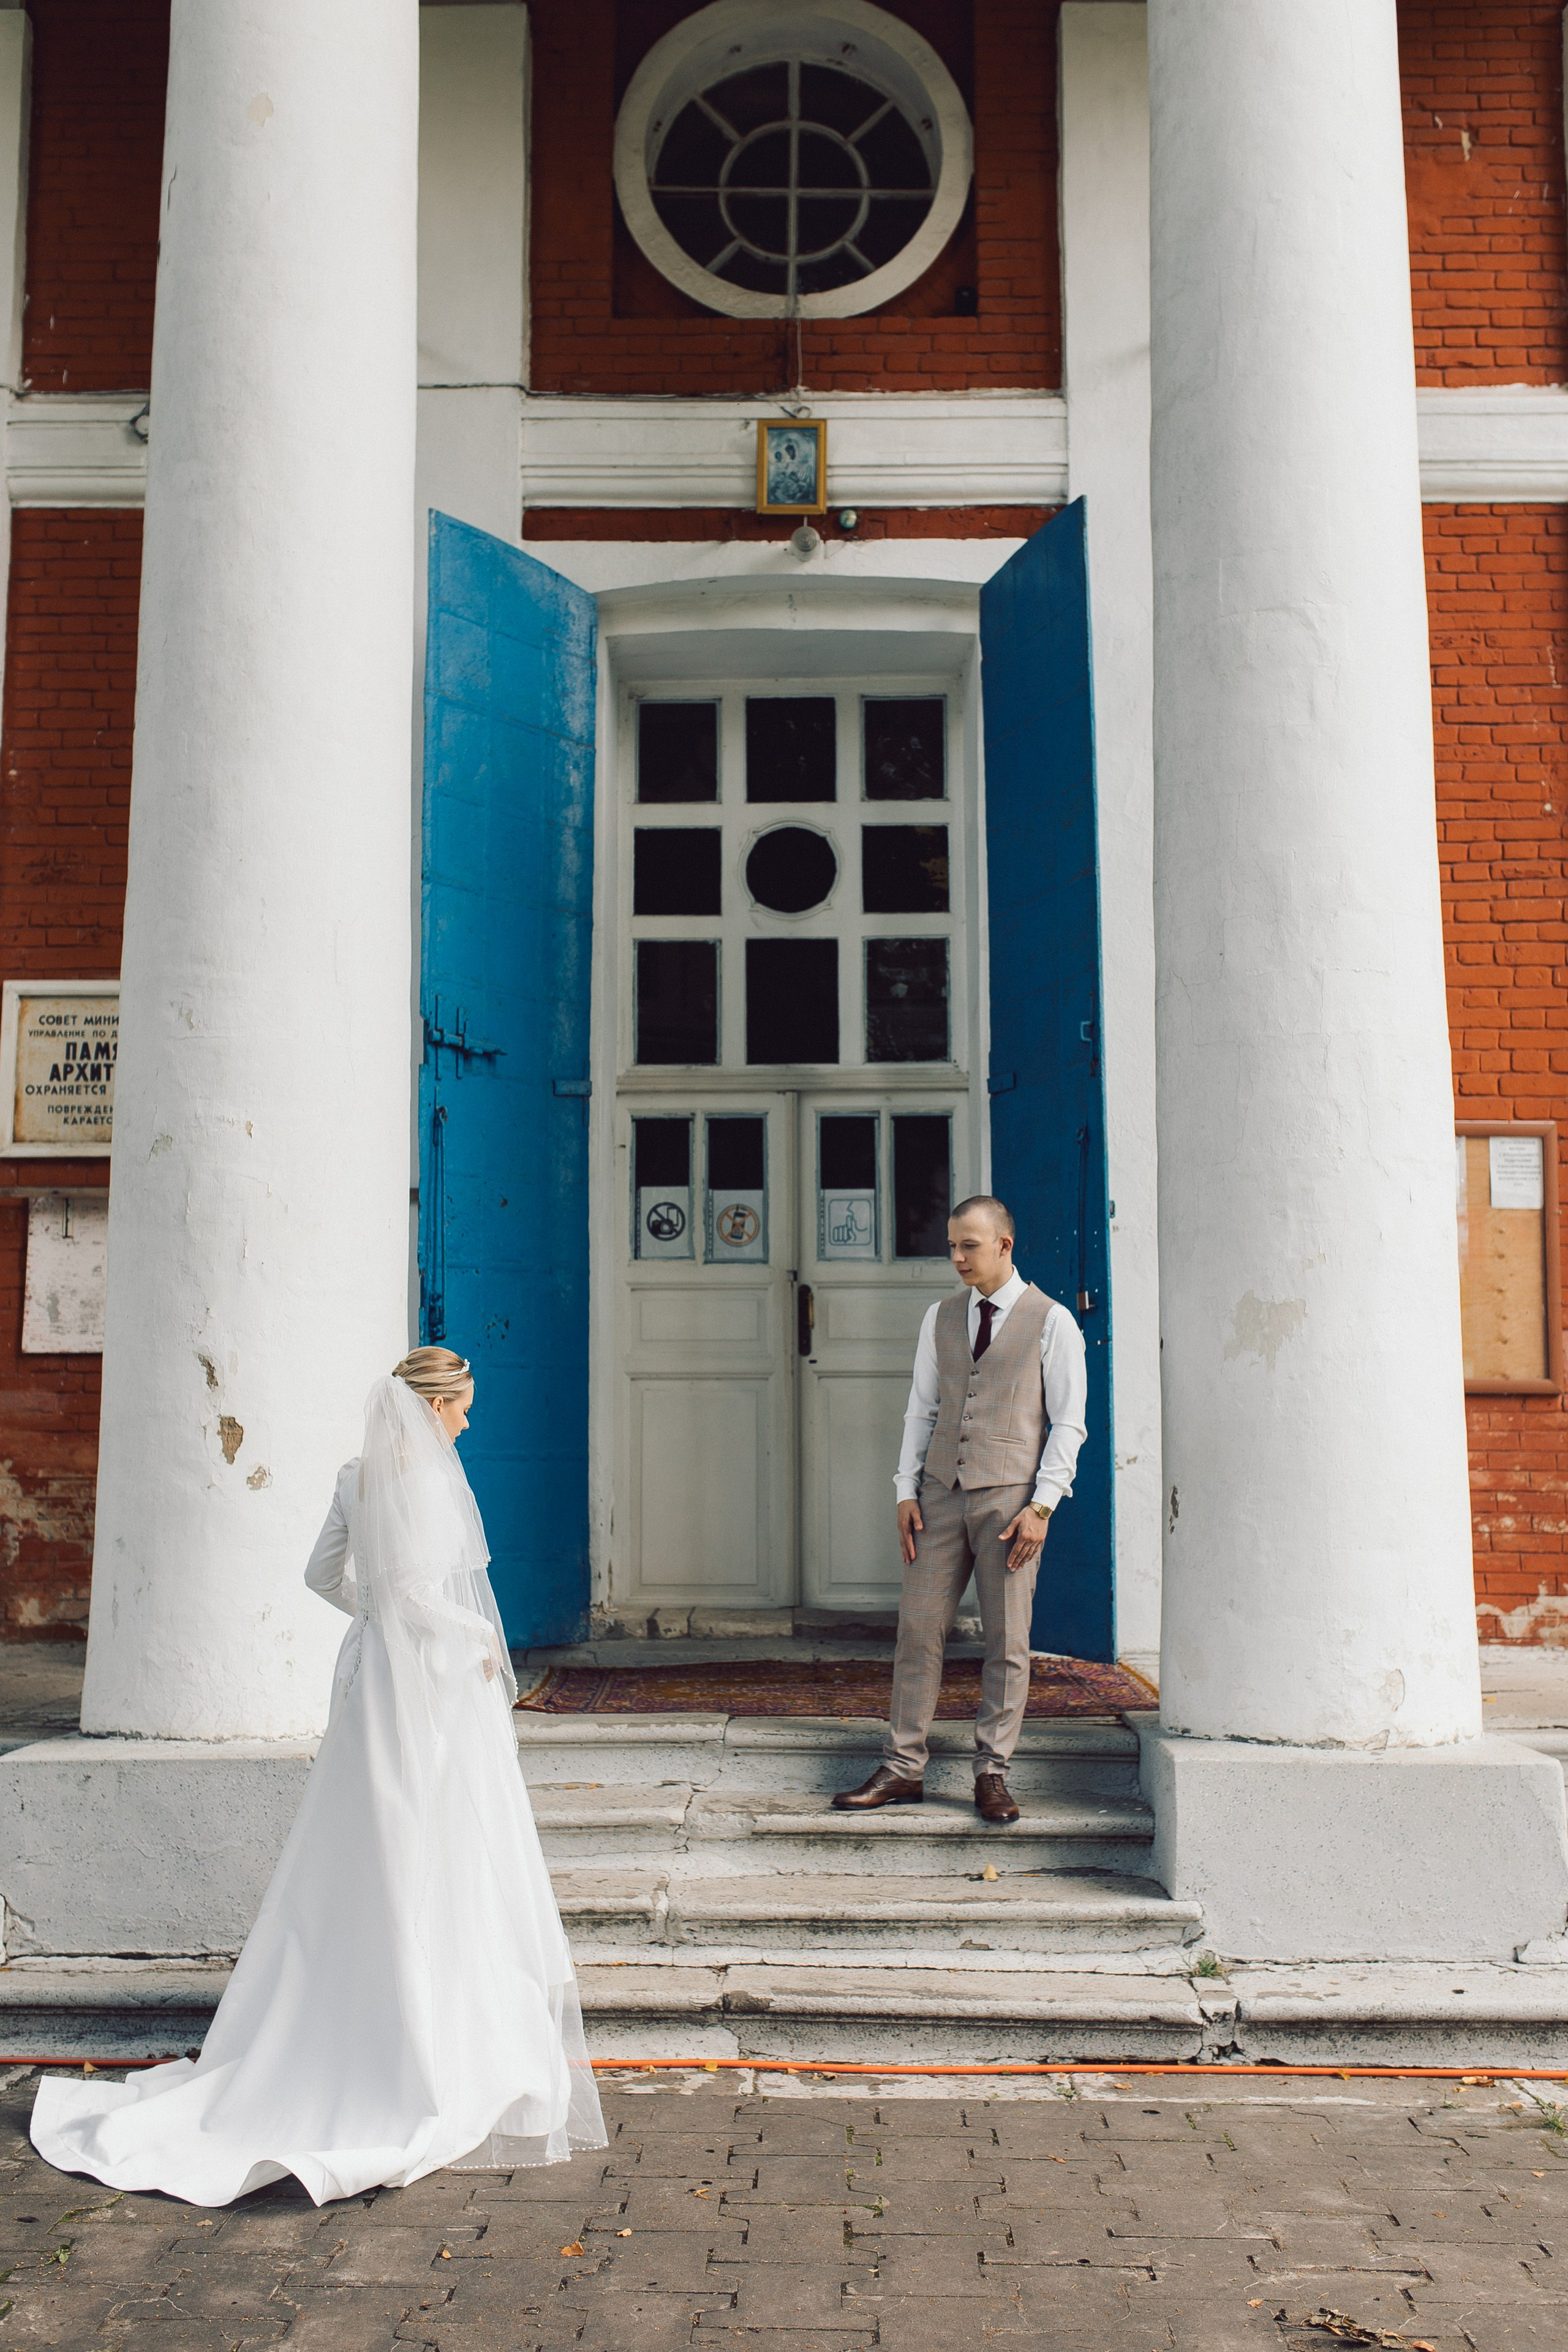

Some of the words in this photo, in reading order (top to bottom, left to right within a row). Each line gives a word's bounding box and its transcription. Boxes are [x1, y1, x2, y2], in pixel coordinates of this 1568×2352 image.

[38, 1015, 77, 1026] СОВЕТ
[83, 1015, 119, 1026] МИНИ
[28, 1029, 85, 1038] УПРАВЛЕНИЕ
[50, 1063, 114, 1082] АРХИТ
[25, 1084, 107, 1095] ОХРАНЯЕТСЯ
[63, 1116, 113, 1125] КАРАЕТС
